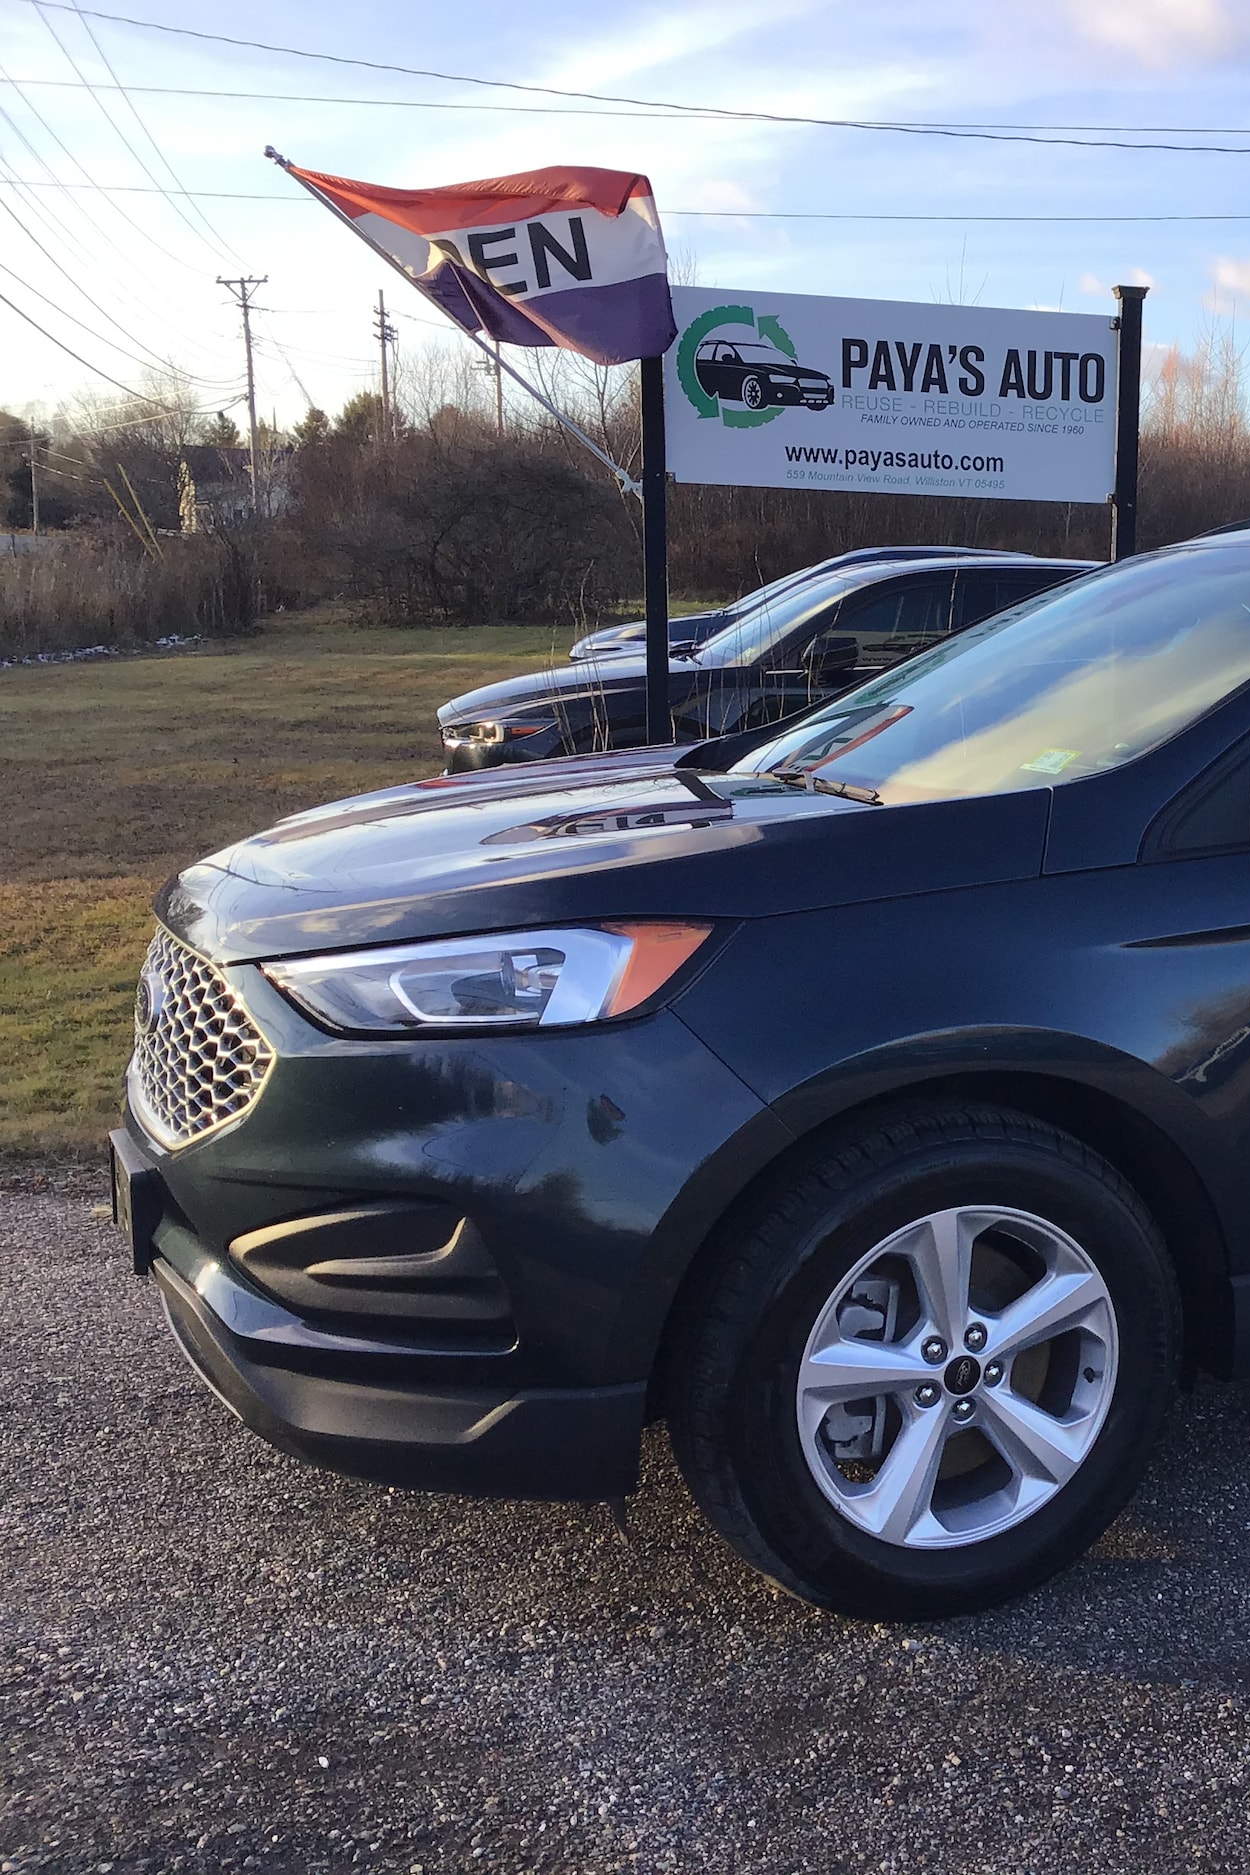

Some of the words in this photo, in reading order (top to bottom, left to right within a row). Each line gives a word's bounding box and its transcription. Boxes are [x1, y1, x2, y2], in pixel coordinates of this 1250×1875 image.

[842, 338, 985, 397] PAYA'S
[998, 349, 1105, 404] AUTO
[841, 395, 902, 412] REUSE
[924, 399, 1001, 417] REBUILD
[1022, 405, 1104, 423] RECYCLE
[860, 413, 899, 425] FAMILY
[900, 416, 941, 427] OWNED
[942, 419, 966, 429] AND
[968, 420, 1025, 432] OPERATED
[1026, 423, 1059, 434] SINCE
[1062, 426, 1085, 435] 1960
[784, 446, 1004, 472] www.payasauto.com
[786, 469, 806, 480] 559
[807, 471, 854, 483] Mountain
[856, 473, 881, 483] View
[915, 476, 956, 487] Williston
[958, 478, 973, 487] VT
[974, 479, 1005, 489] 05495
